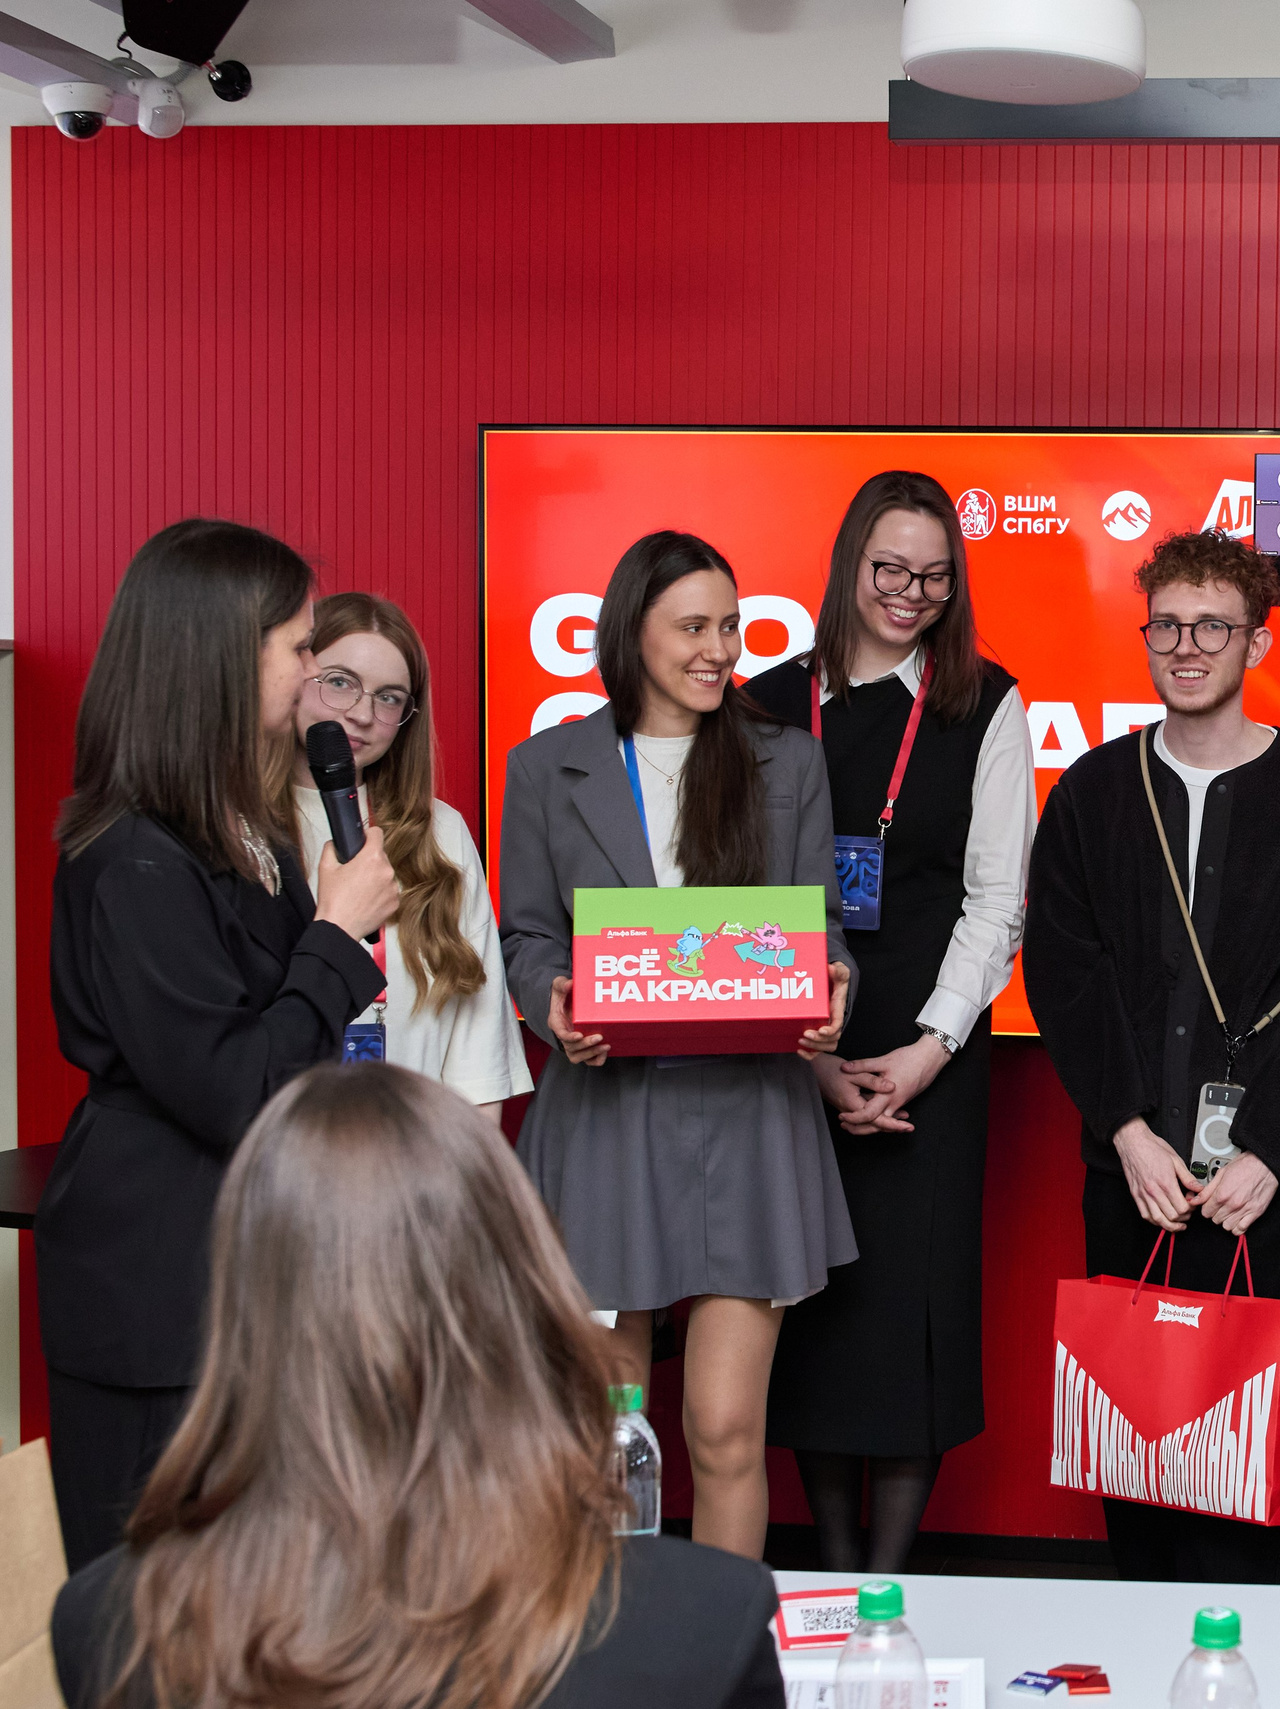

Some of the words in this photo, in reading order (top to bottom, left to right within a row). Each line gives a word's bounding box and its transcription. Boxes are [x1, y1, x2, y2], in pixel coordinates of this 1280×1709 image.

[1004, 495, 1056, 512] ВШМ
[1003, 517, 1071, 535] СПбГУ
[607, 930, 630, 939] Альфа
[594, 948, 662, 977] ВСЁ
[594, 981, 644, 1003] НА
[647, 971, 814, 1002] КРАСНЫЙ
[1161, 1308, 1181, 1317] Альфа
[1181, 1311, 1196, 1319] Банк
[1050, 1340, 1086, 1490] ДЛЯ
[1086, 1375, 1149, 1500] УМНЫХ
[1149, 1439, 1159, 1503] И
[1160, 1362, 1277, 1522] СВОБОДНЫХ
